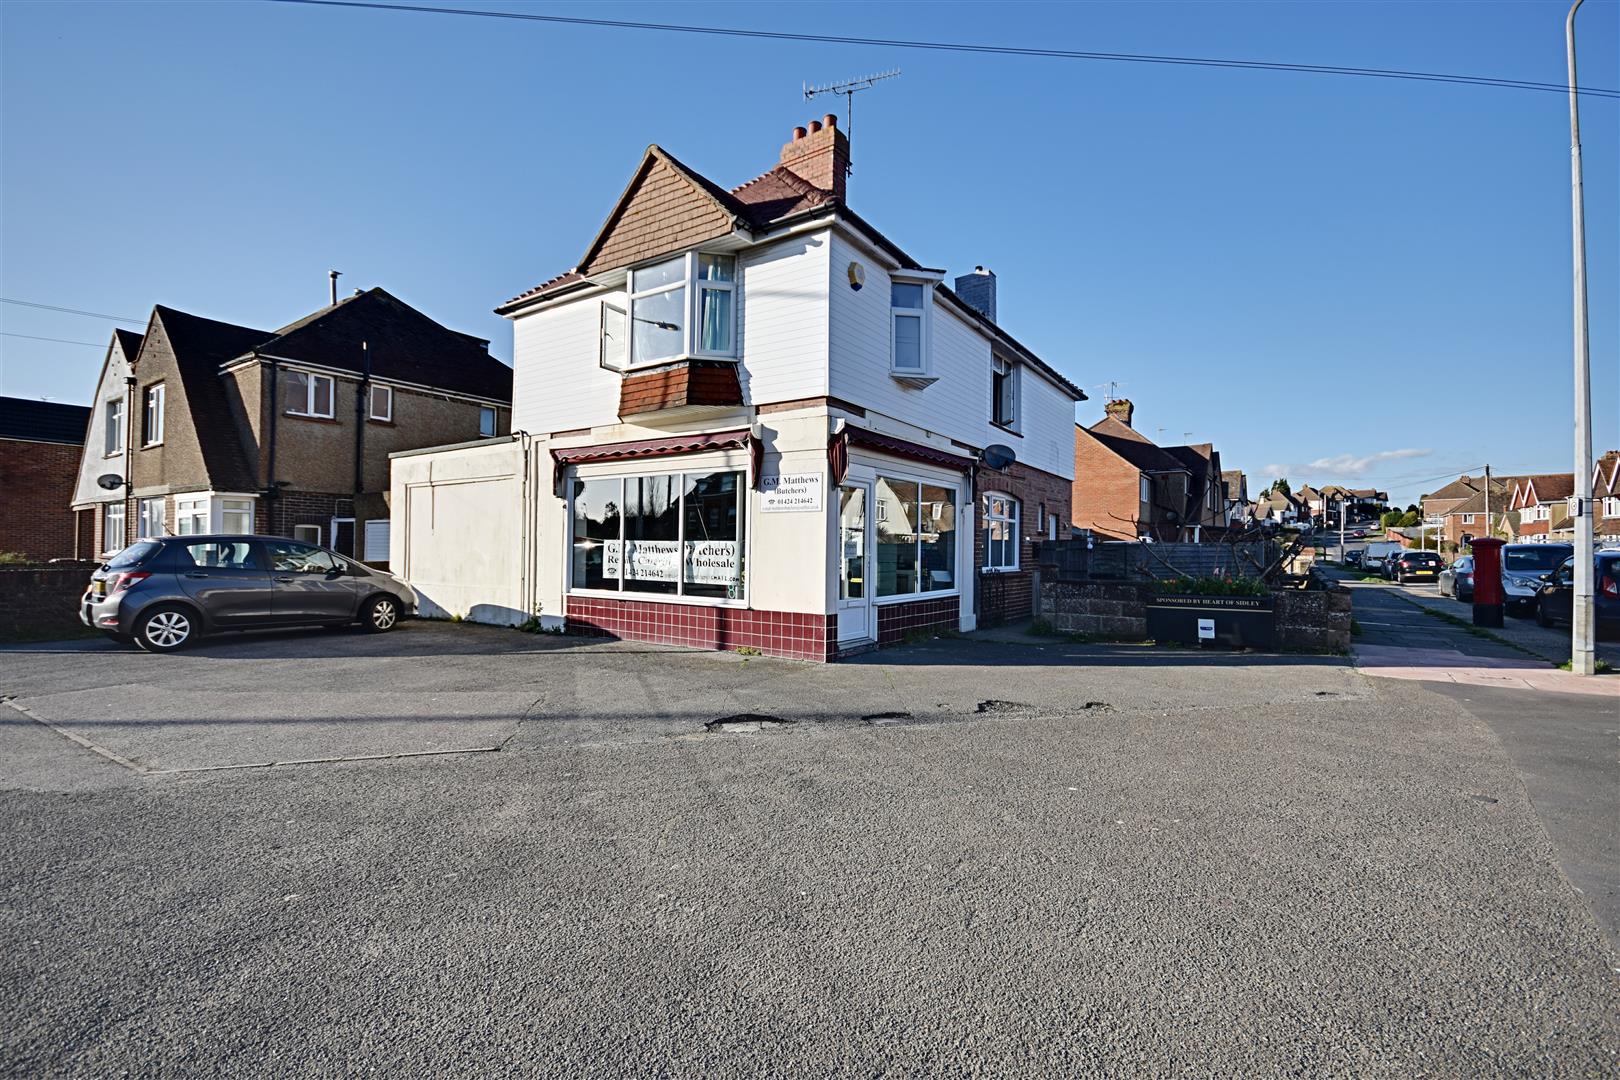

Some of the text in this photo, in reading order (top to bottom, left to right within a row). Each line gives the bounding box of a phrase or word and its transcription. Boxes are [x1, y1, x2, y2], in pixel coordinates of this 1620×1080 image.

[783, 476, 819, 485] Matthews
[775, 487, 807, 495] (Butchers)
[685, 557, 735, 569] Wholesale
[640, 568, 664, 578] 214642
[1156, 597, 1192, 605] SPONSORED
